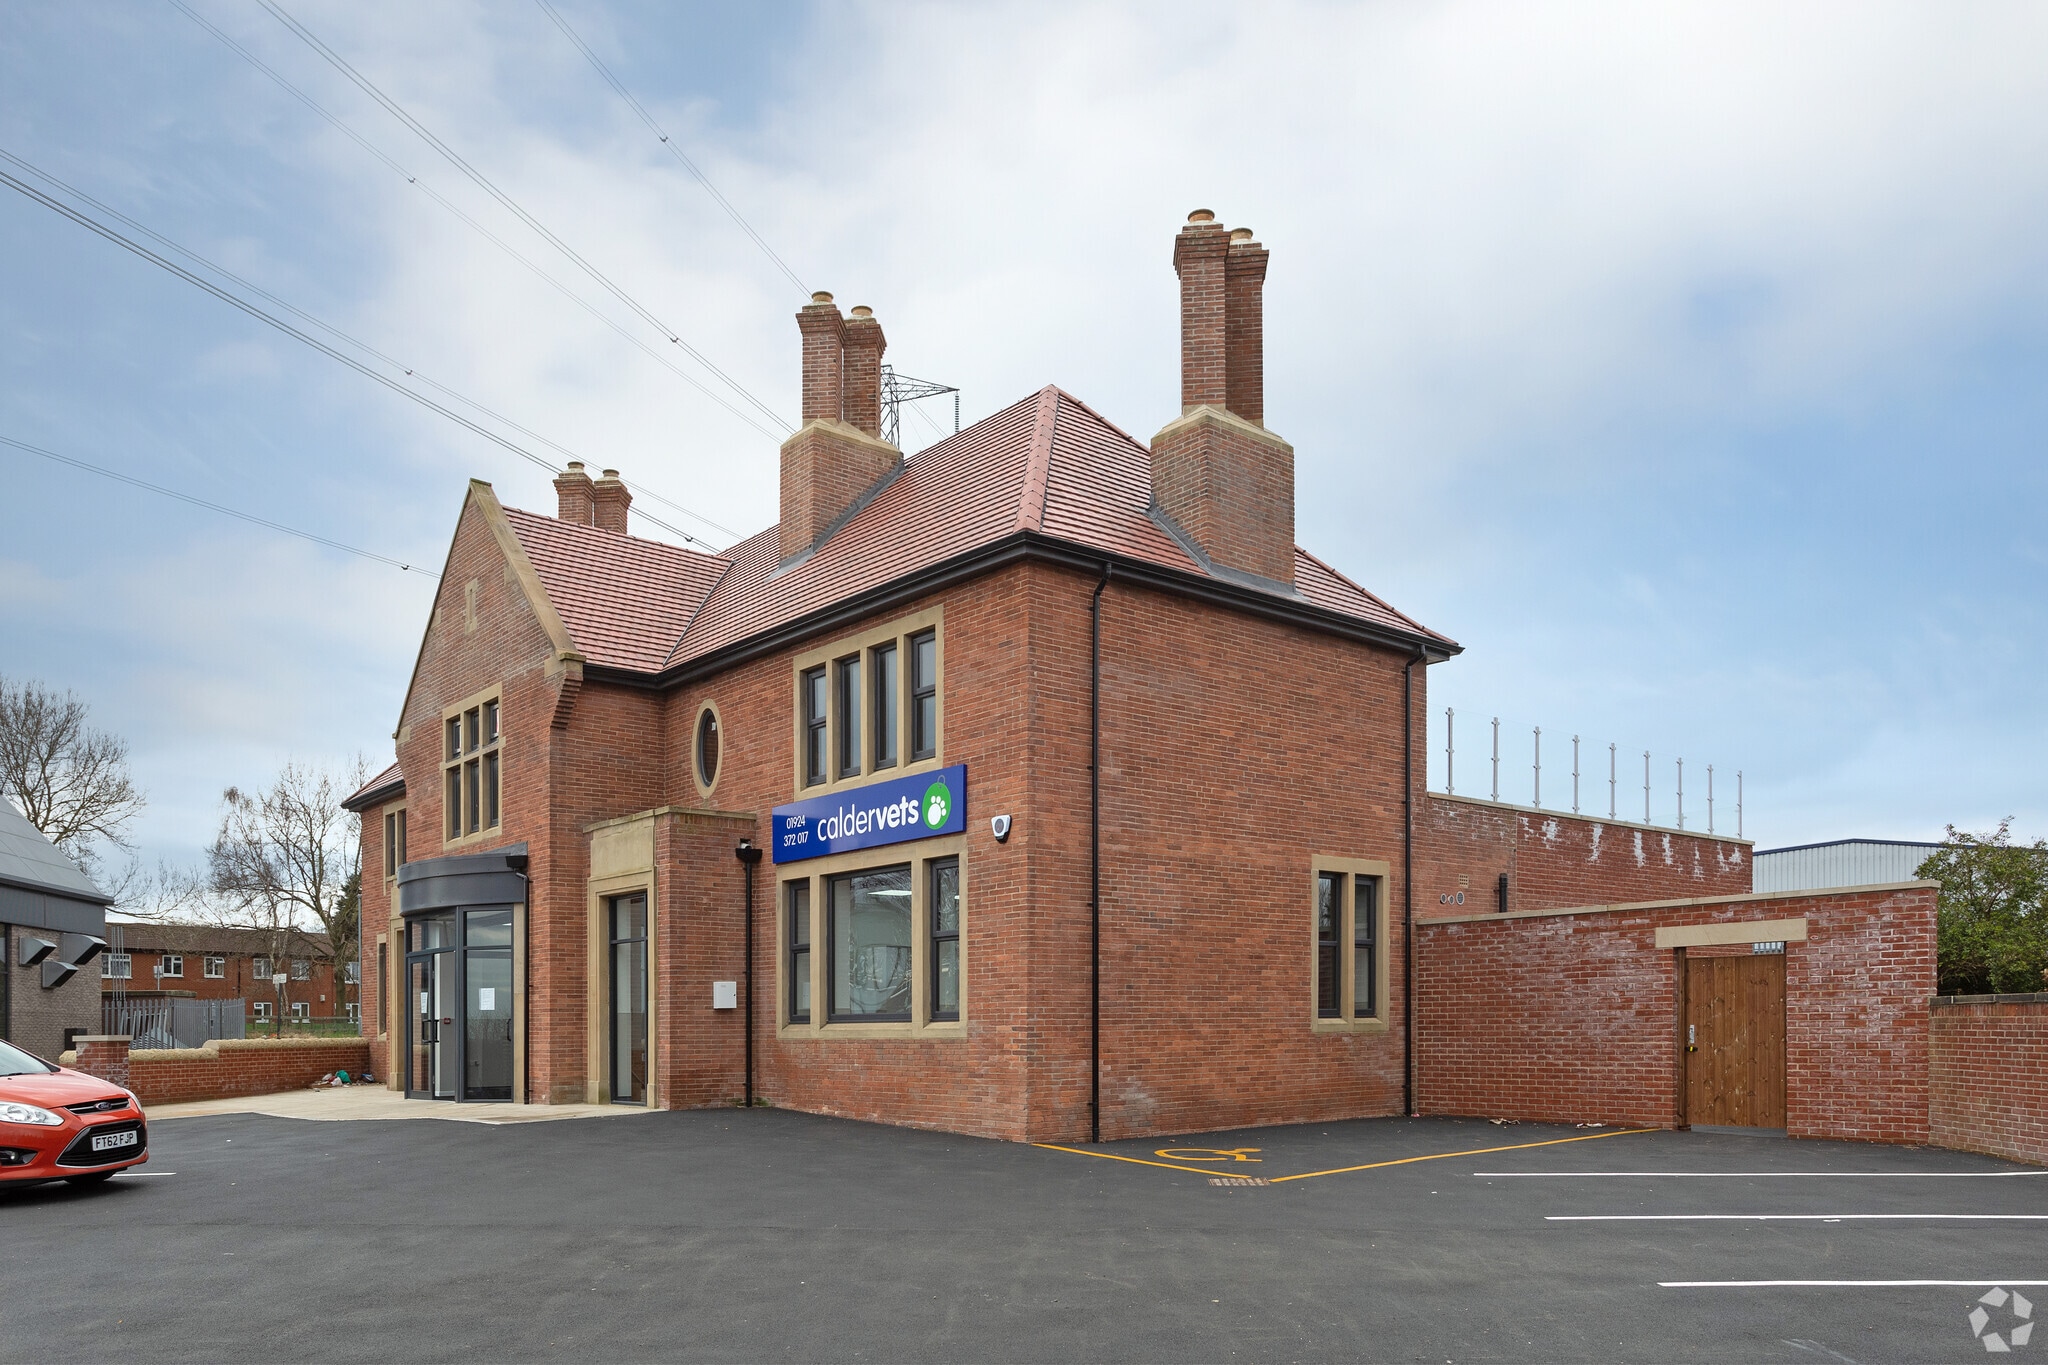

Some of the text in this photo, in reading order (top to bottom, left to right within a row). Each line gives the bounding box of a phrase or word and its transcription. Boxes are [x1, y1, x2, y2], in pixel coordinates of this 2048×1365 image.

[786, 815, 806, 830] 01924
[817, 796, 919, 841] caldervets
[784, 832, 808, 847] 372 017
[96, 1134, 134, 1148] FT62 FJP
